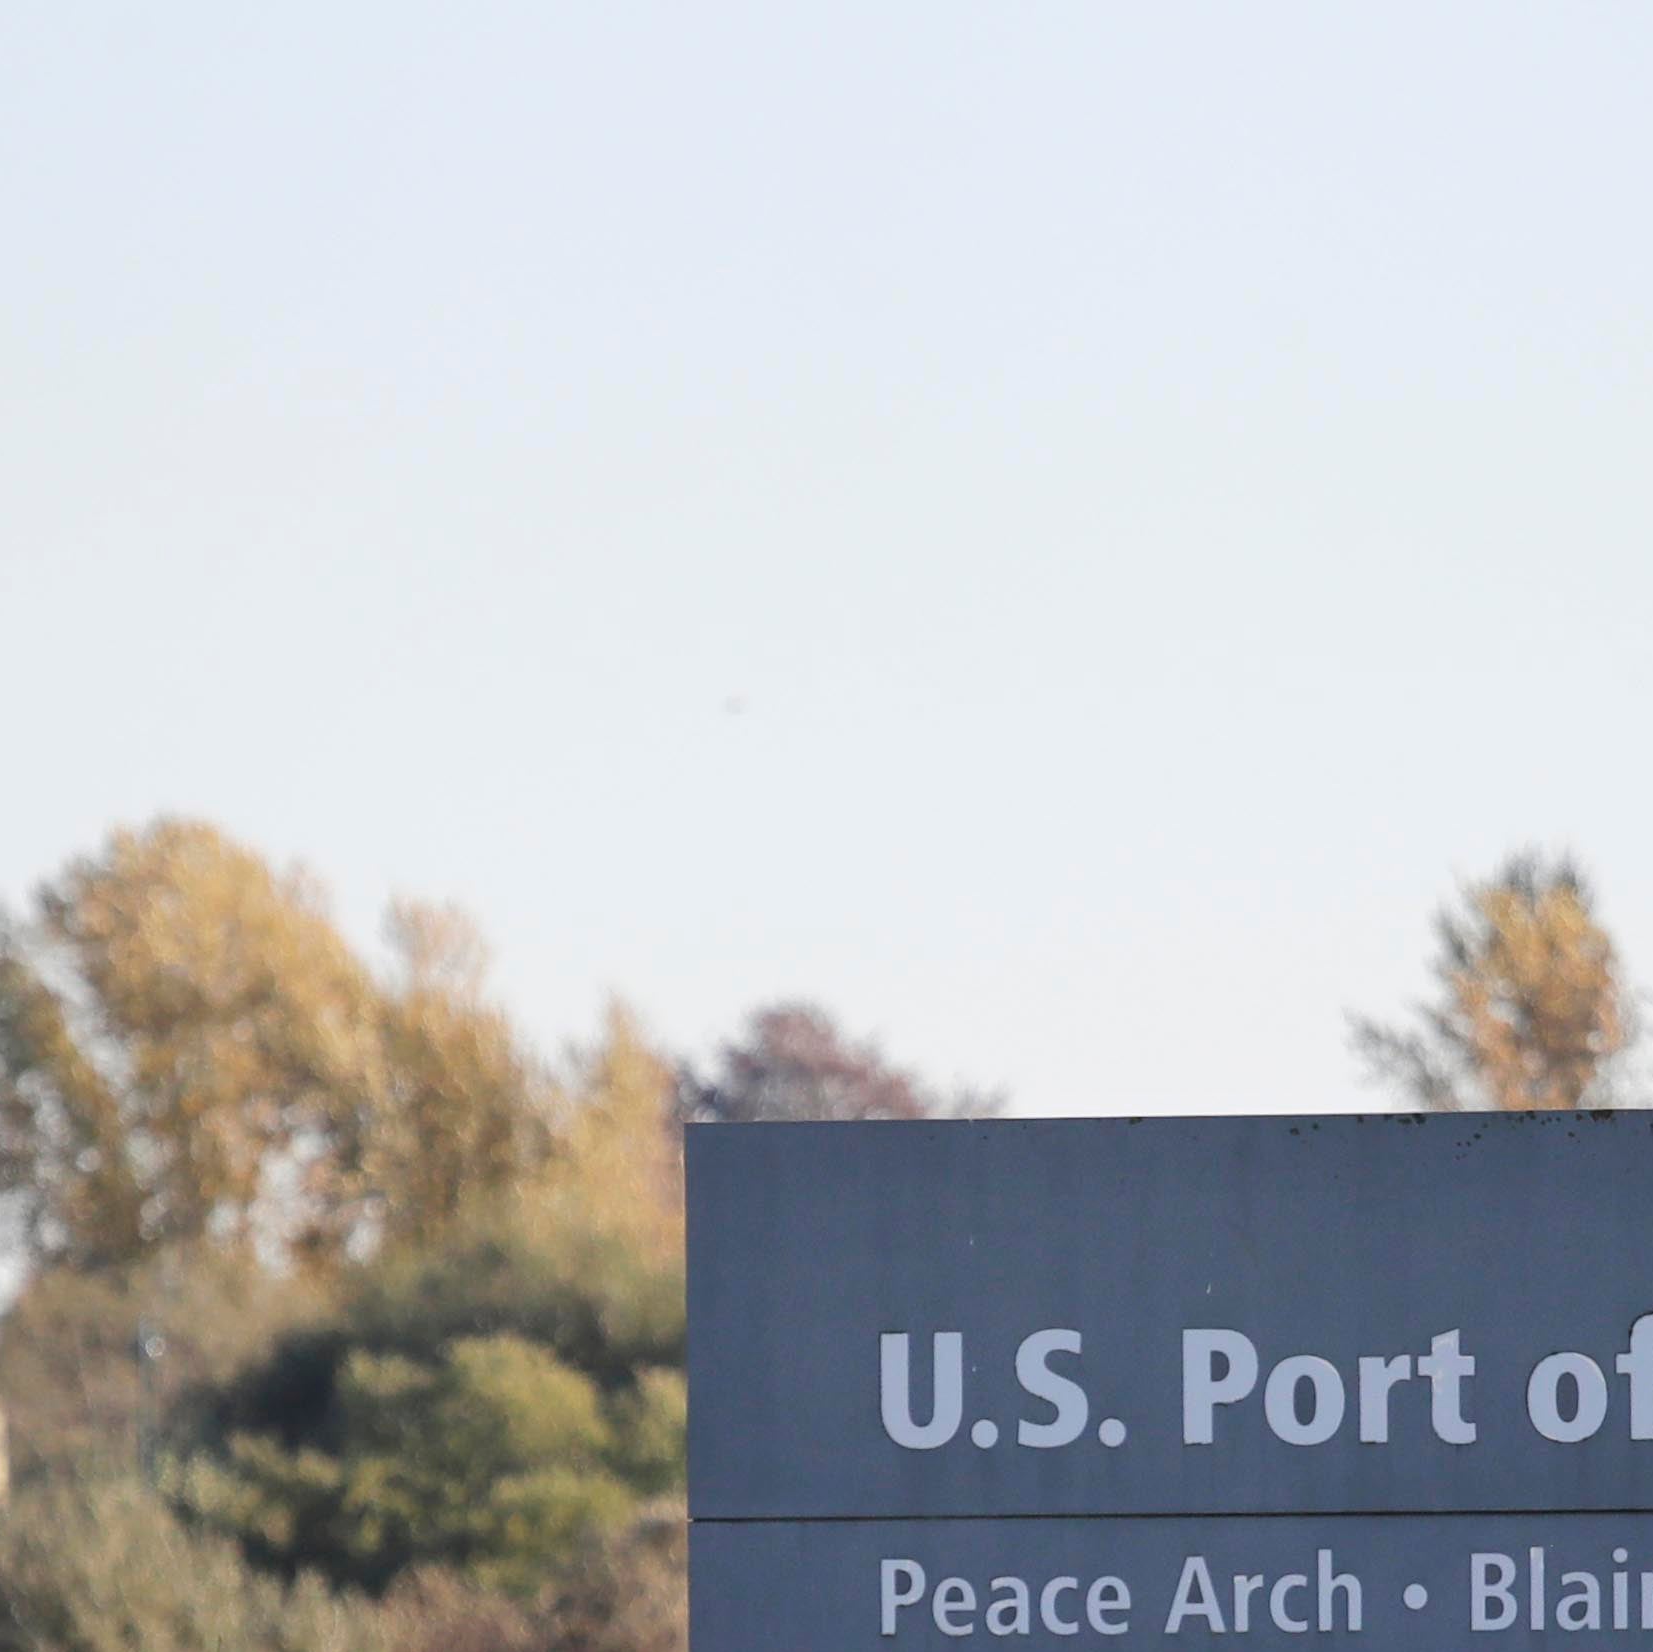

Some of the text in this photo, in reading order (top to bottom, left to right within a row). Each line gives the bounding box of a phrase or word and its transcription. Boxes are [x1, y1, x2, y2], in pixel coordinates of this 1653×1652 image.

[880, 1328, 1127, 1449] U.S.
[1182, 1328, 1477, 1445] Port
[880, 1558, 1131, 1636] Peace
[1164, 1549, 1362, 1634] Arch
